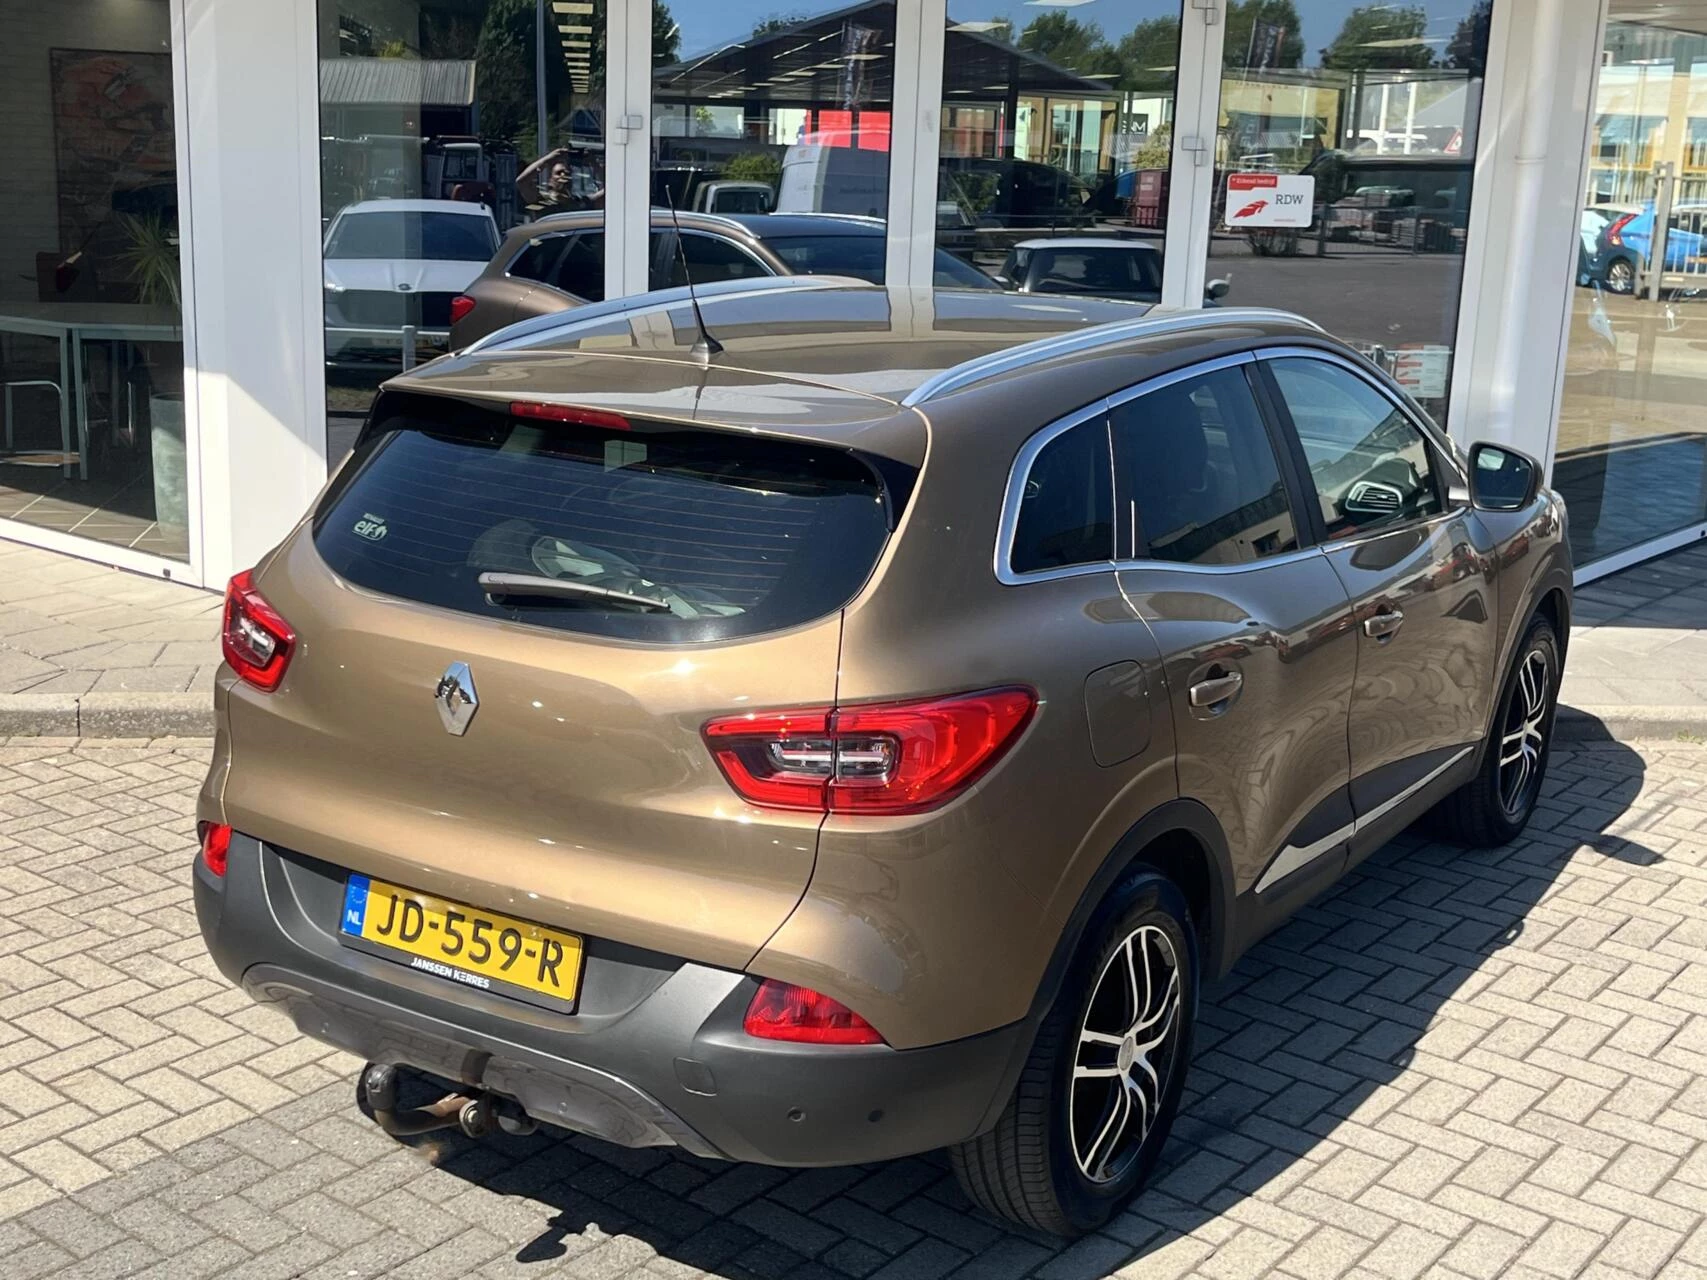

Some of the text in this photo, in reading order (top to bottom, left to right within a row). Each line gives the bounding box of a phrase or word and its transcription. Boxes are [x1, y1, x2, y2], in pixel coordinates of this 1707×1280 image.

[1275, 194, 1304, 205] RDW
[346, 910, 362, 926] NL
[376, 894, 564, 988] JD-559-R
[410, 957, 490, 989] JANSSEN KERRES
